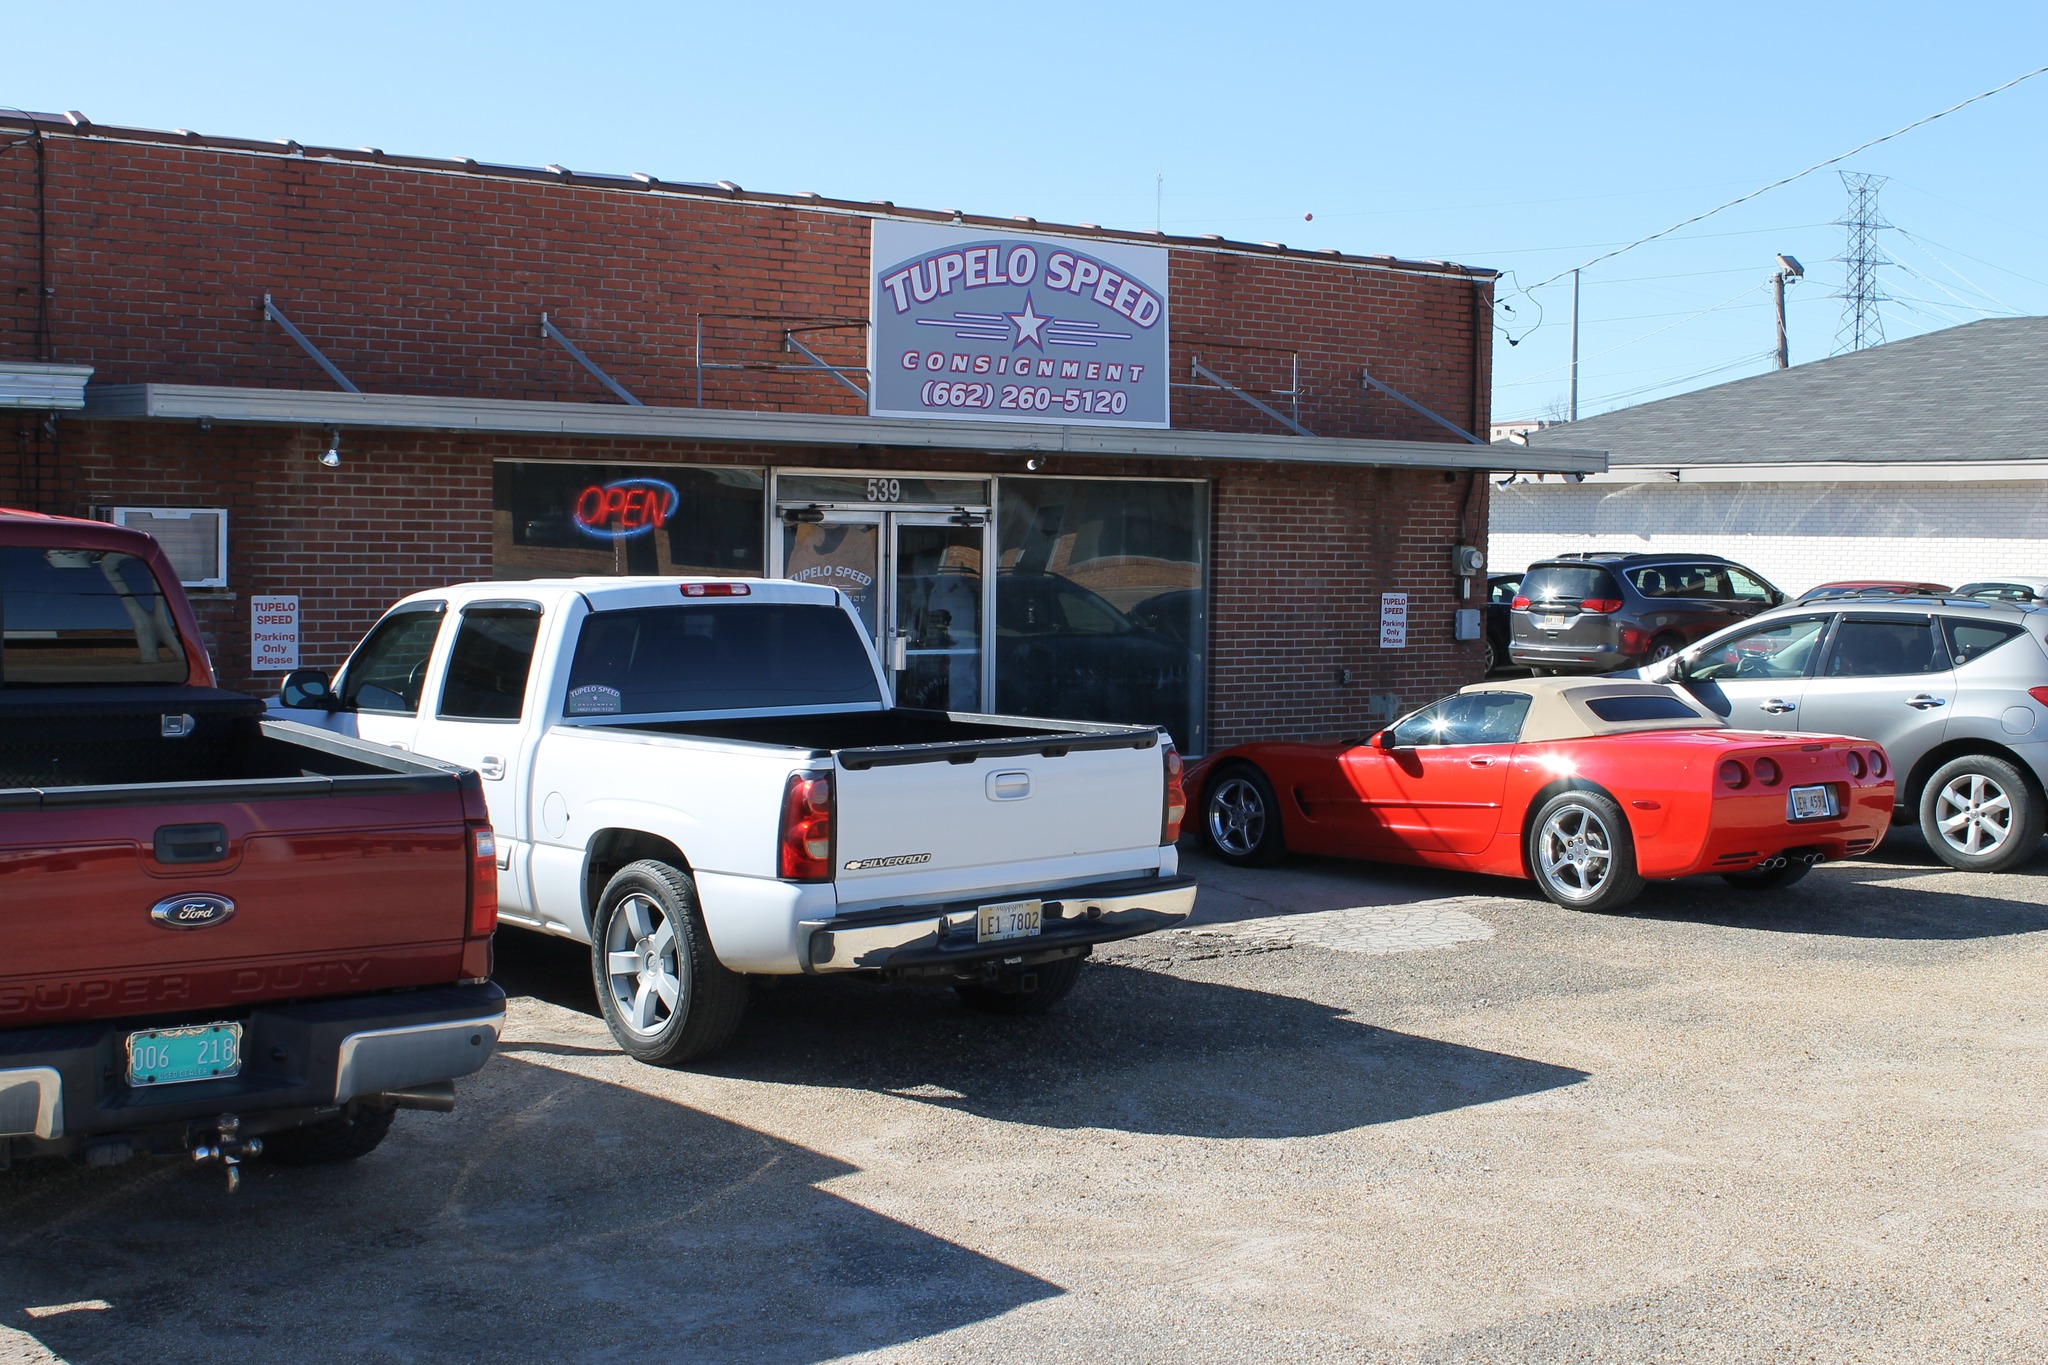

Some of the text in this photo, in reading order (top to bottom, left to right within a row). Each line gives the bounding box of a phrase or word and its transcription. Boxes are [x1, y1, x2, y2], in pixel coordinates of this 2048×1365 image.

[882, 245, 1162, 329] TUPELO SPEED
[901, 351, 1145, 383] CONSIGNMENT
[921, 380, 1128, 414] (662) 260-5120
[867, 478, 900, 502] 539
[576, 484, 672, 528] OPEN
[835, 566, 872, 586] SPEED
[253, 602, 296, 612] TUPELO
[256, 615, 293, 625] SPEED
[1382, 620, 1404, 628] Parking
[254, 632, 296, 643] Parking
[263, 644, 287, 654] Only
[256, 655, 293, 665] Please
[571, 686, 620, 698] TUPELO SPEED
[860, 853, 932, 869] SILVERADO
[179, 903, 214, 920] Ford
[980, 911, 1039, 936] LE1 7802
[231, 960, 372, 995] DUTY
[133, 1038, 234, 1071] 006 218
